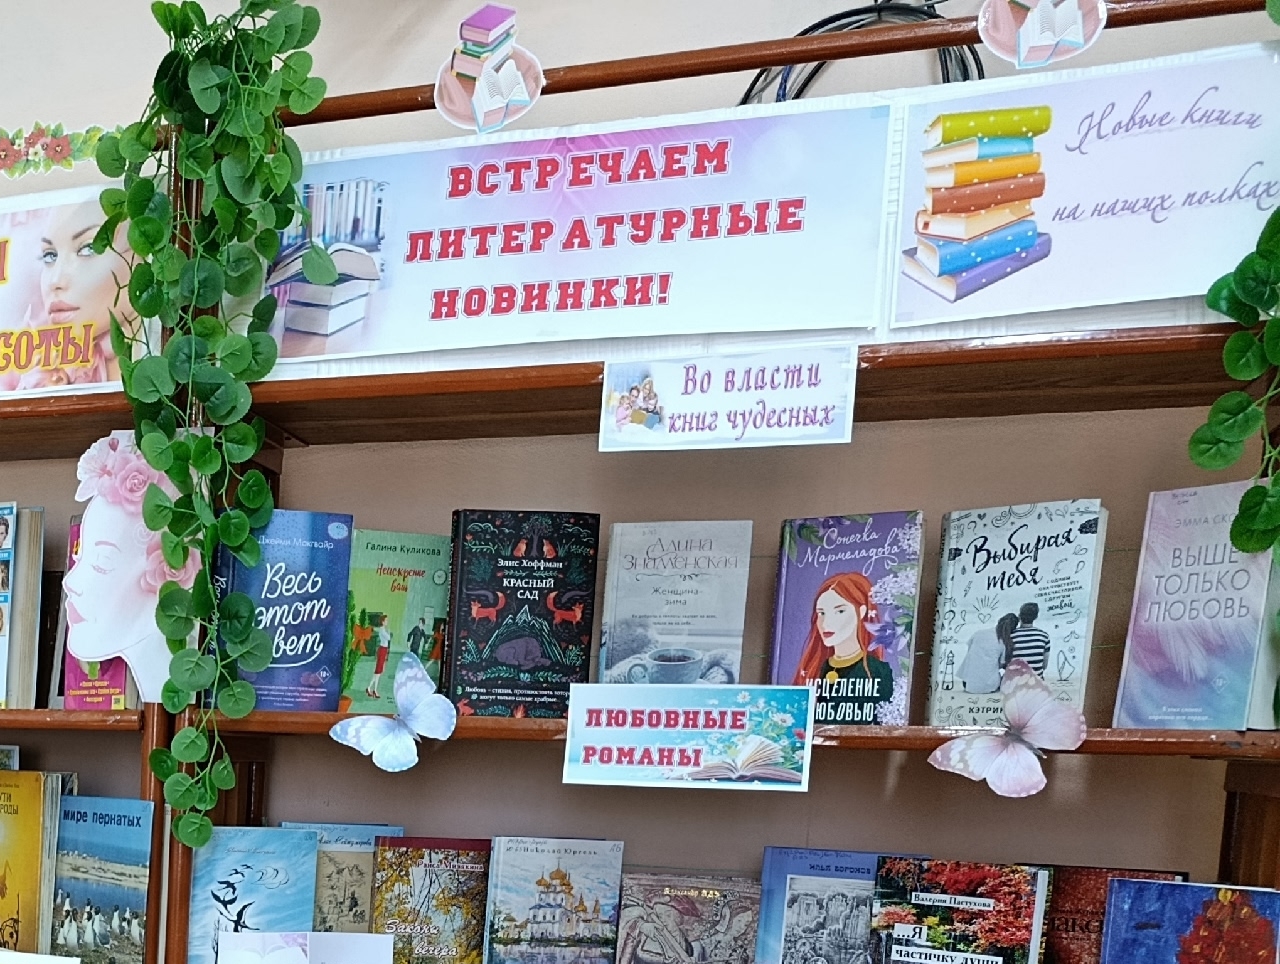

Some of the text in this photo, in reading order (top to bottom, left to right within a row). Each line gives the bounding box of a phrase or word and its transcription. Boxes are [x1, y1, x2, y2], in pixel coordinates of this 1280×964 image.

[1065, 86, 1263, 154] Новые книги
[446, 138, 732, 200] ВСТРЕЧАЕМ
[1052, 161, 1280, 224] на наших полках
[403, 196, 807, 264] ЛИТЕРАТУРНЫЕ
[428, 272, 673, 321] НОВИНКИ!
[682, 362, 822, 396] Во власти
[668, 400, 836, 440] книг чудесных
[823, 518, 880, 549] Сонечка
[366, 542, 441, 556] Галина Куликова
[798, 528, 901, 576] Мармеладова
[966, 523, 1078, 573] Выбирая
[1171, 543, 1240, 568] ВЫШЕ
[498, 559, 563, 570] Элис Хоффман
[623, 554, 738, 570] Знаменская
[261, 563, 321, 598] Весь
[503, 578, 554, 587] КРАСНЫЙ
[1155, 568, 1251, 595] ТОЛЬКО
[517, 590, 538, 600] САД
[252, 598, 331, 629] этот
[1144, 597, 1251, 623] ЛЮБОВЬ
[584, 708, 748, 731] ЛЮБОВНЫЕ
[582, 746, 704, 768] РОМАНЫ
[63, 808, 142, 828] мире пернатых
[385, 919, 440, 934] Законы
[415, 942, 458, 957] вечера
